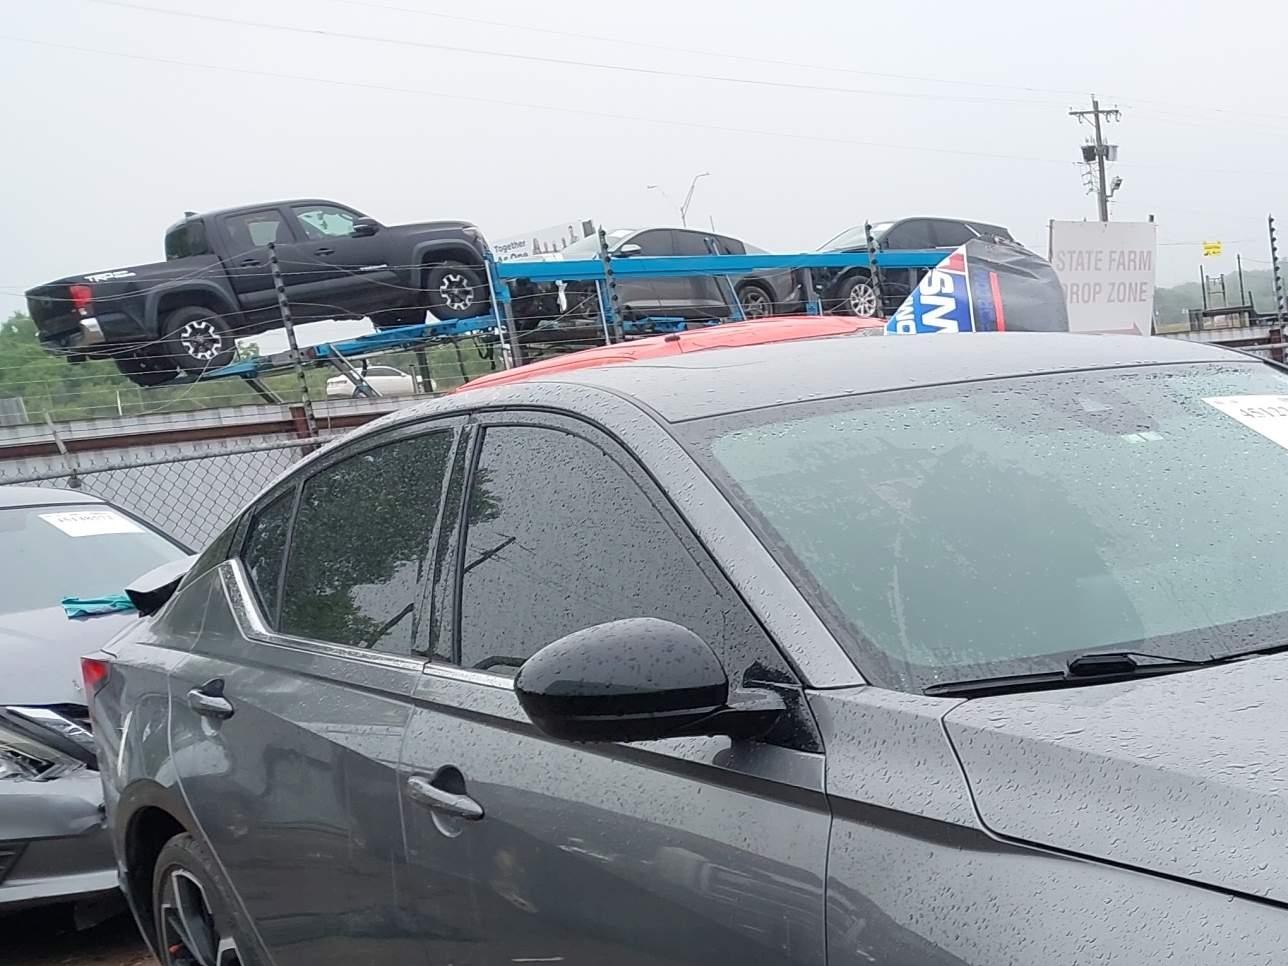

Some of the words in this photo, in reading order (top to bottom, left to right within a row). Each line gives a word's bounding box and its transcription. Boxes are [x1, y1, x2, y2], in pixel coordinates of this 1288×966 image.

[493, 240, 526, 253] Together
[1056, 250, 1104, 272] STATE
[1108, 250, 1152, 272] FARM
[1107, 282, 1149, 303] ZONE
